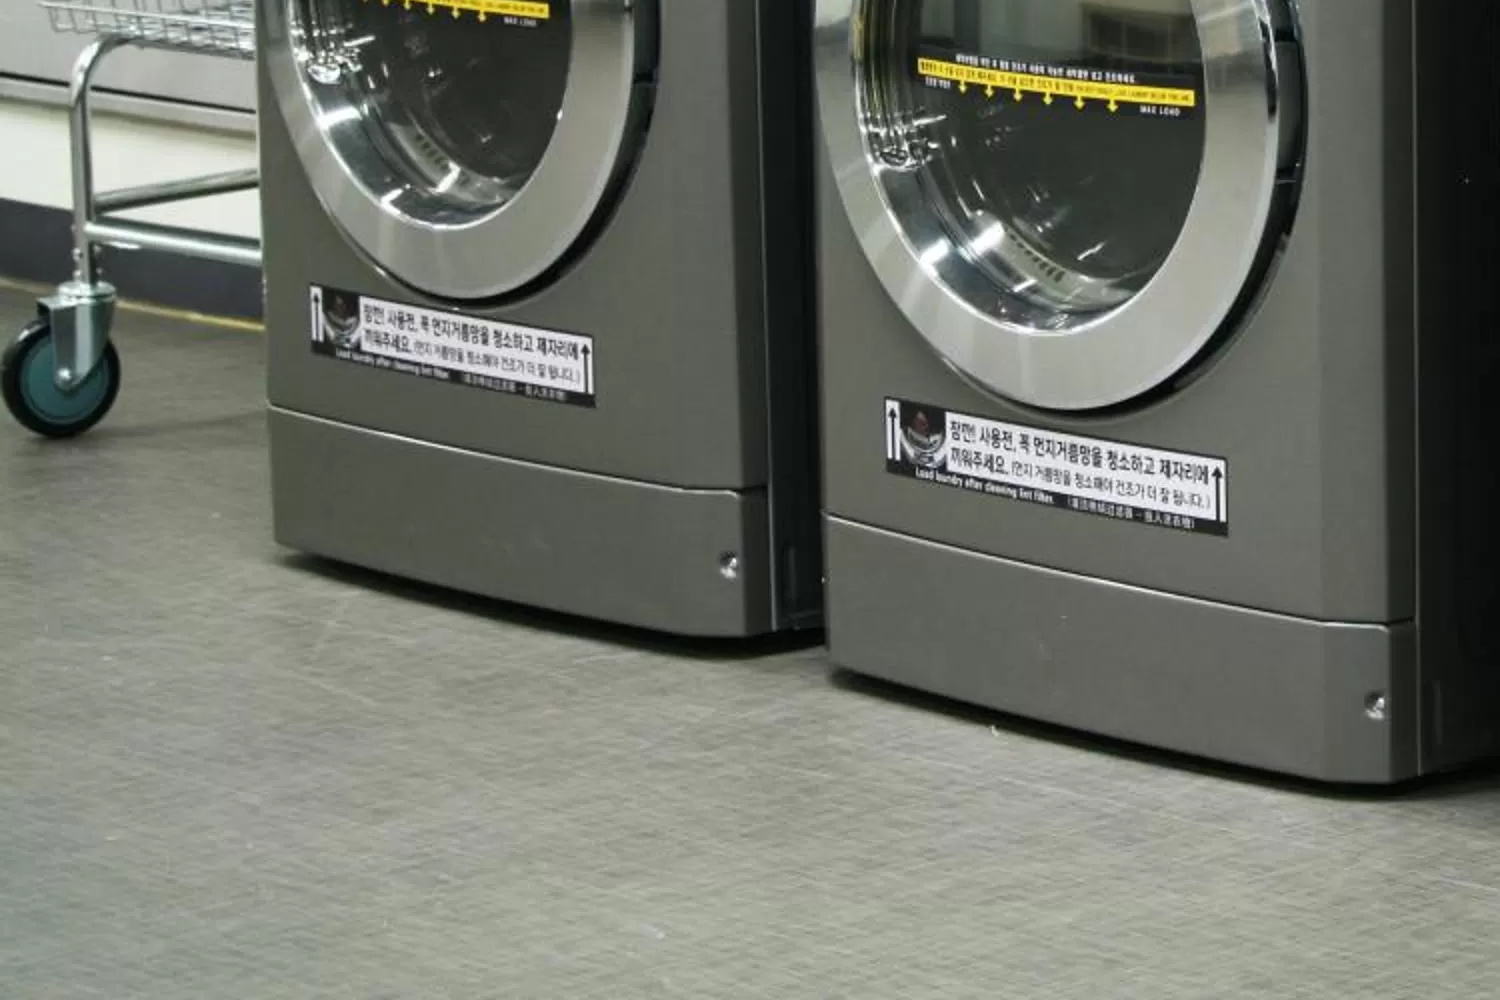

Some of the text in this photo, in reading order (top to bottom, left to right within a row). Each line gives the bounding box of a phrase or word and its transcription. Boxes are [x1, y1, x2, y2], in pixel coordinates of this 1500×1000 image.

[493, 328, 534, 353] 청소하고
[537, 336, 579, 361] 제자리에
[950, 420, 1209, 485] 잠깐! 사용전, 꼭 먼지거름망을 청소하고 제자리에
[950, 447, 1009, 475] 끼워주세요.
[1115, 479, 1145, 500] 건조가
[1147, 485, 1157, 500] 더
